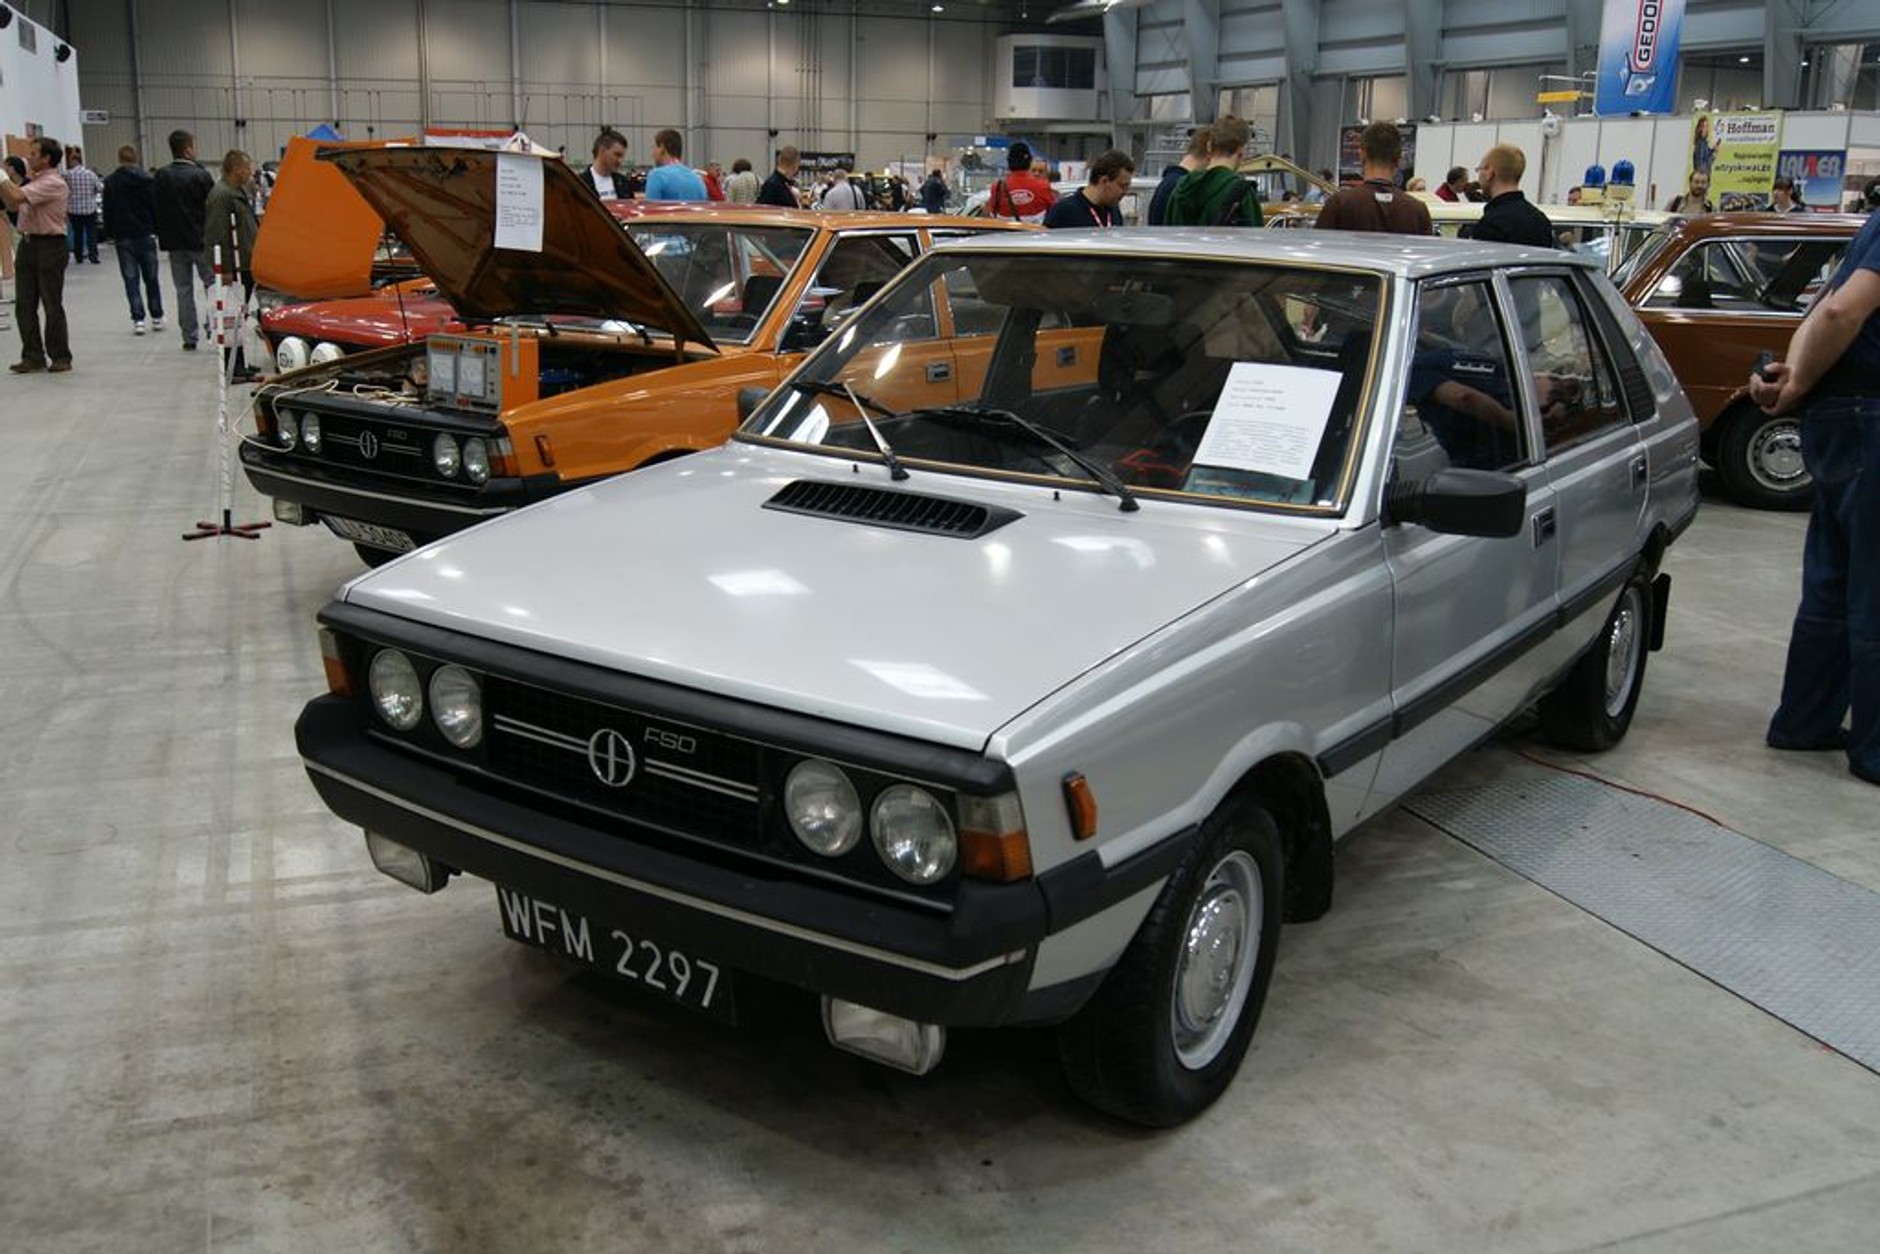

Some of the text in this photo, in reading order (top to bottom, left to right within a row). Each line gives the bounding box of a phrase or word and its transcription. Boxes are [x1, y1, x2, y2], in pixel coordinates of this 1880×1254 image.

[1638, 0, 1658, 62] GEDO
[1727, 121, 1775, 134] Hoffman
[644, 726, 696, 754] FSO
[501, 887, 720, 1008] WFM 2297
